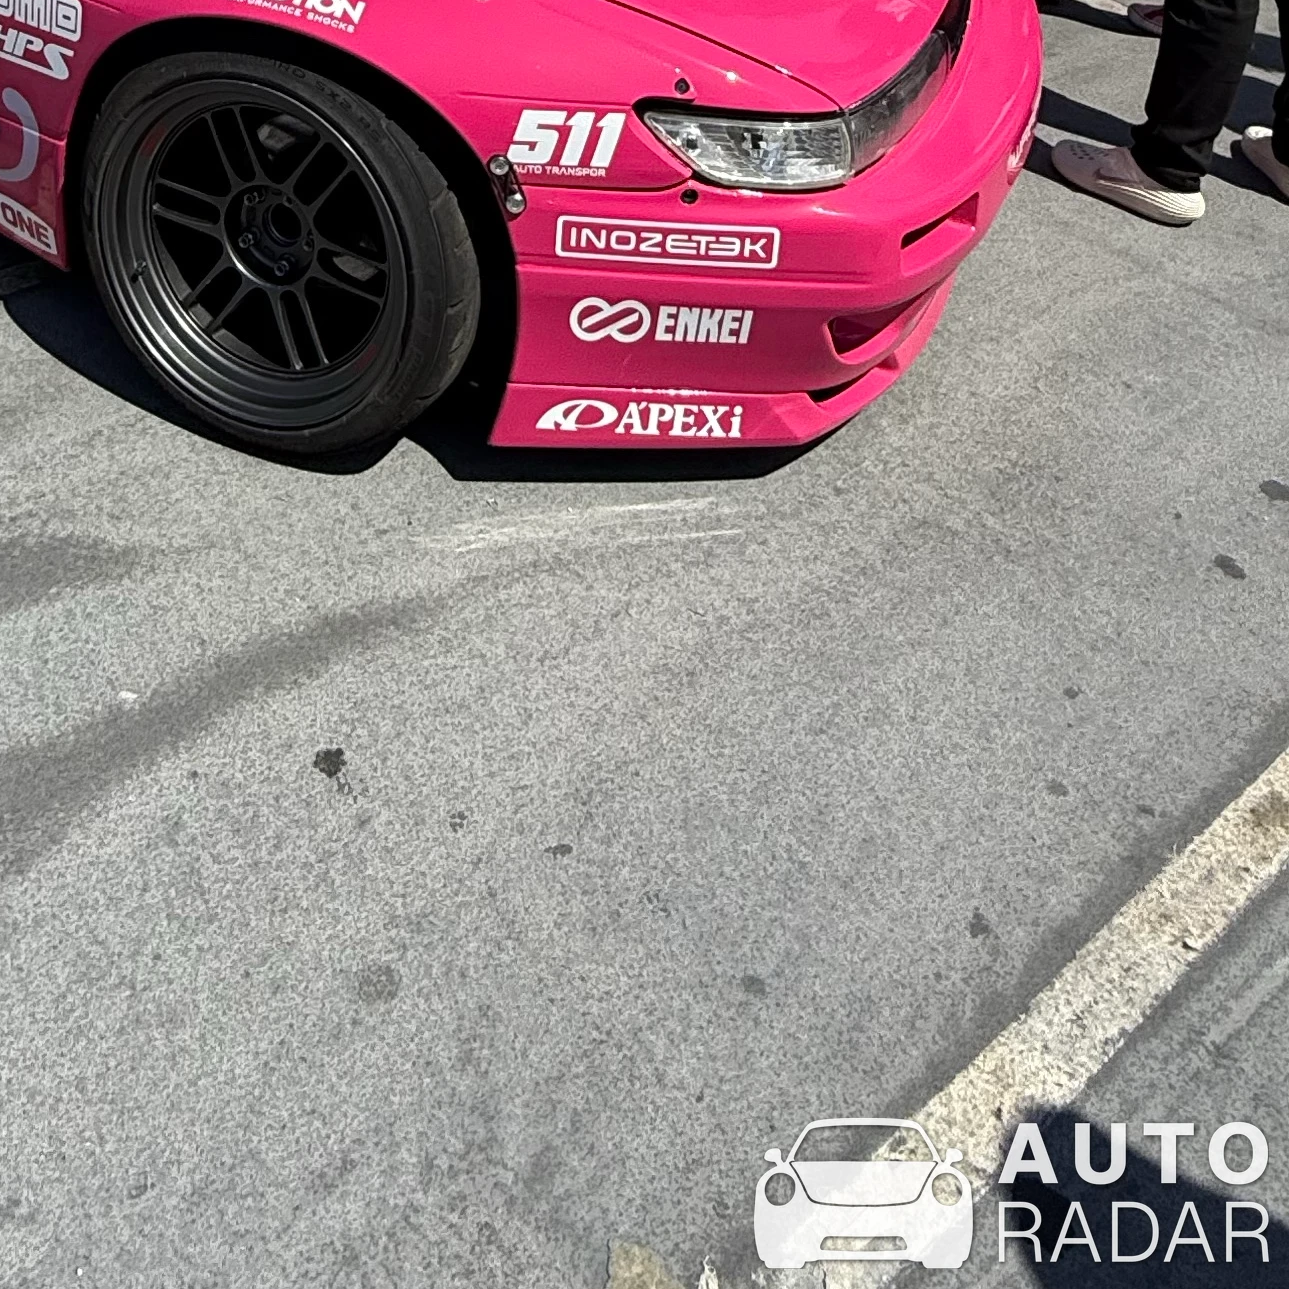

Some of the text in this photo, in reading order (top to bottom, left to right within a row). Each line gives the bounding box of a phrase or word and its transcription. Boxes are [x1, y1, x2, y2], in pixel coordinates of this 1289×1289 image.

[306, 12, 356, 34] SHOCKS
[507, 108, 627, 168] 511
[512, 164, 544, 176] AUTO
[654, 304, 755, 345] ENKEI
